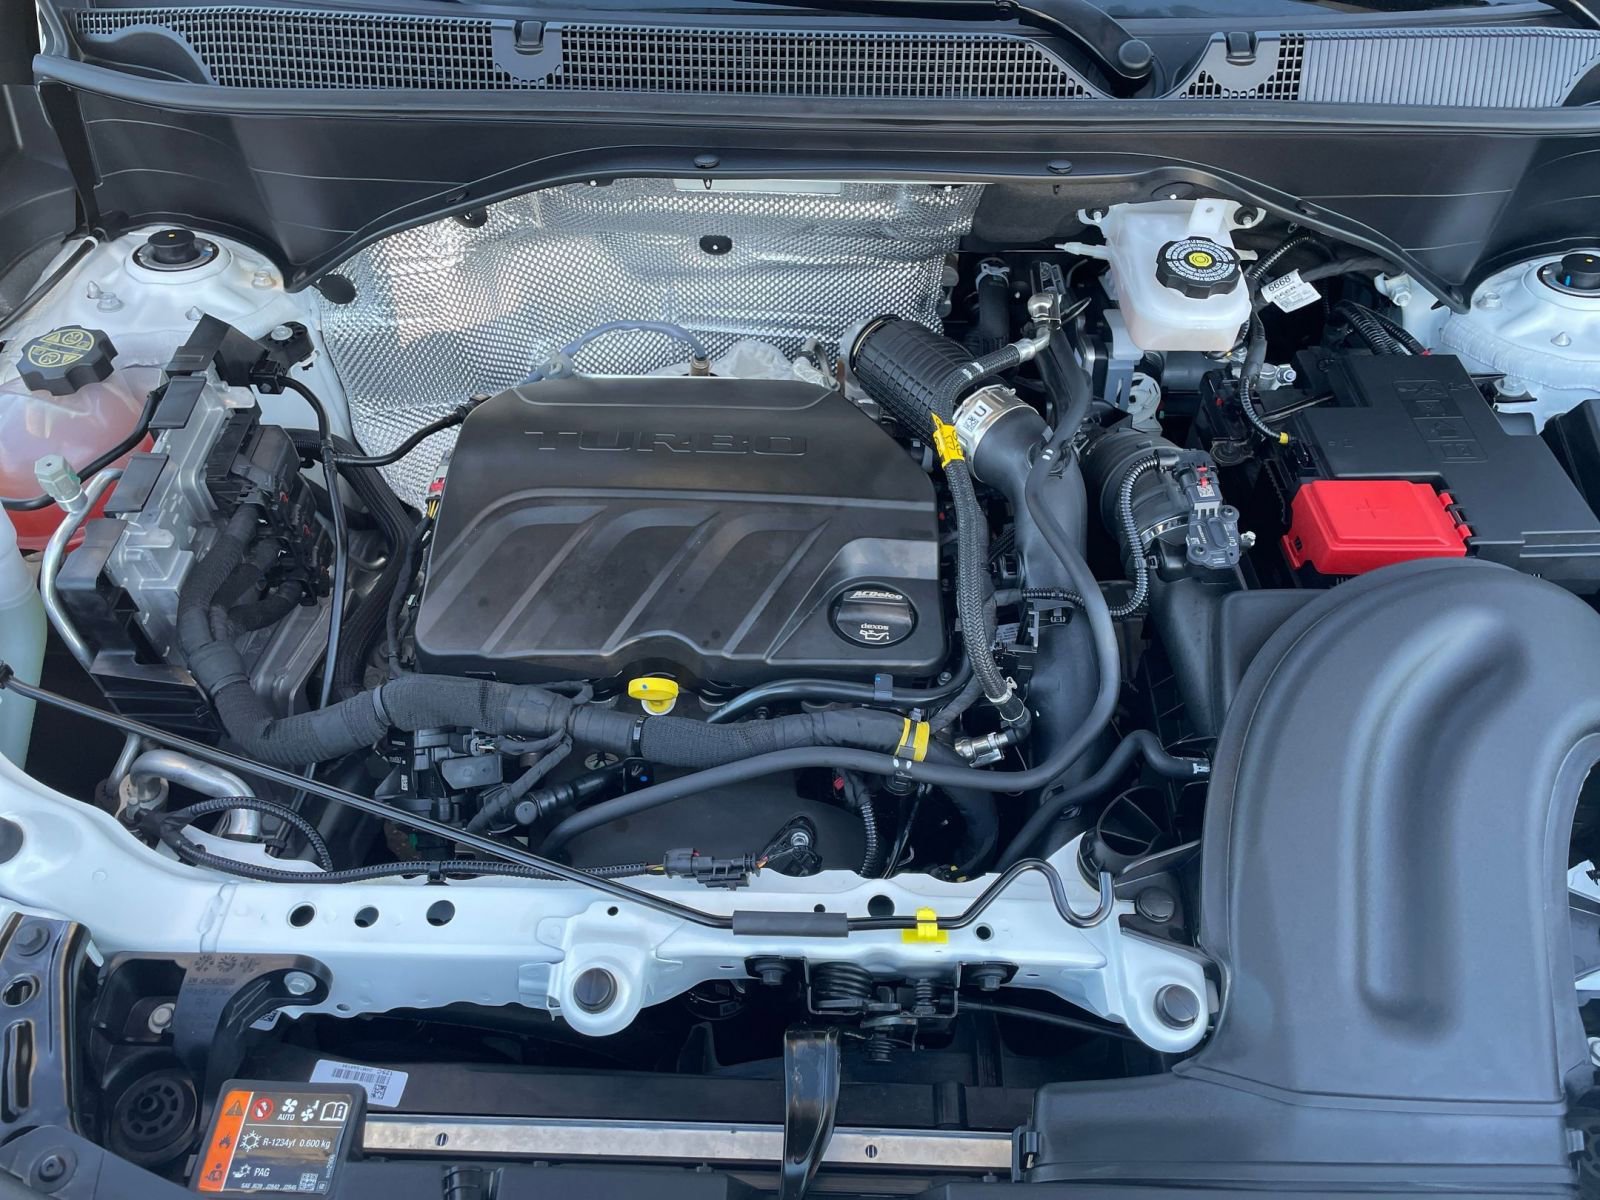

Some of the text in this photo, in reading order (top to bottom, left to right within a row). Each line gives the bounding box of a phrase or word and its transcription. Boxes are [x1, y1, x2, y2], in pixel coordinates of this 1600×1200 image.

[1268, 275, 1291, 291] 6668
[524, 431, 807, 456] TURBO
[850, 590, 903, 600] ACDelco
[861, 622, 889, 630] dexos
[277, 1113, 296, 1121] AUTO
[262, 1137, 331, 1149] R-1234yf 0.600 kg
[254, 1167, 271, 1177] PAG
